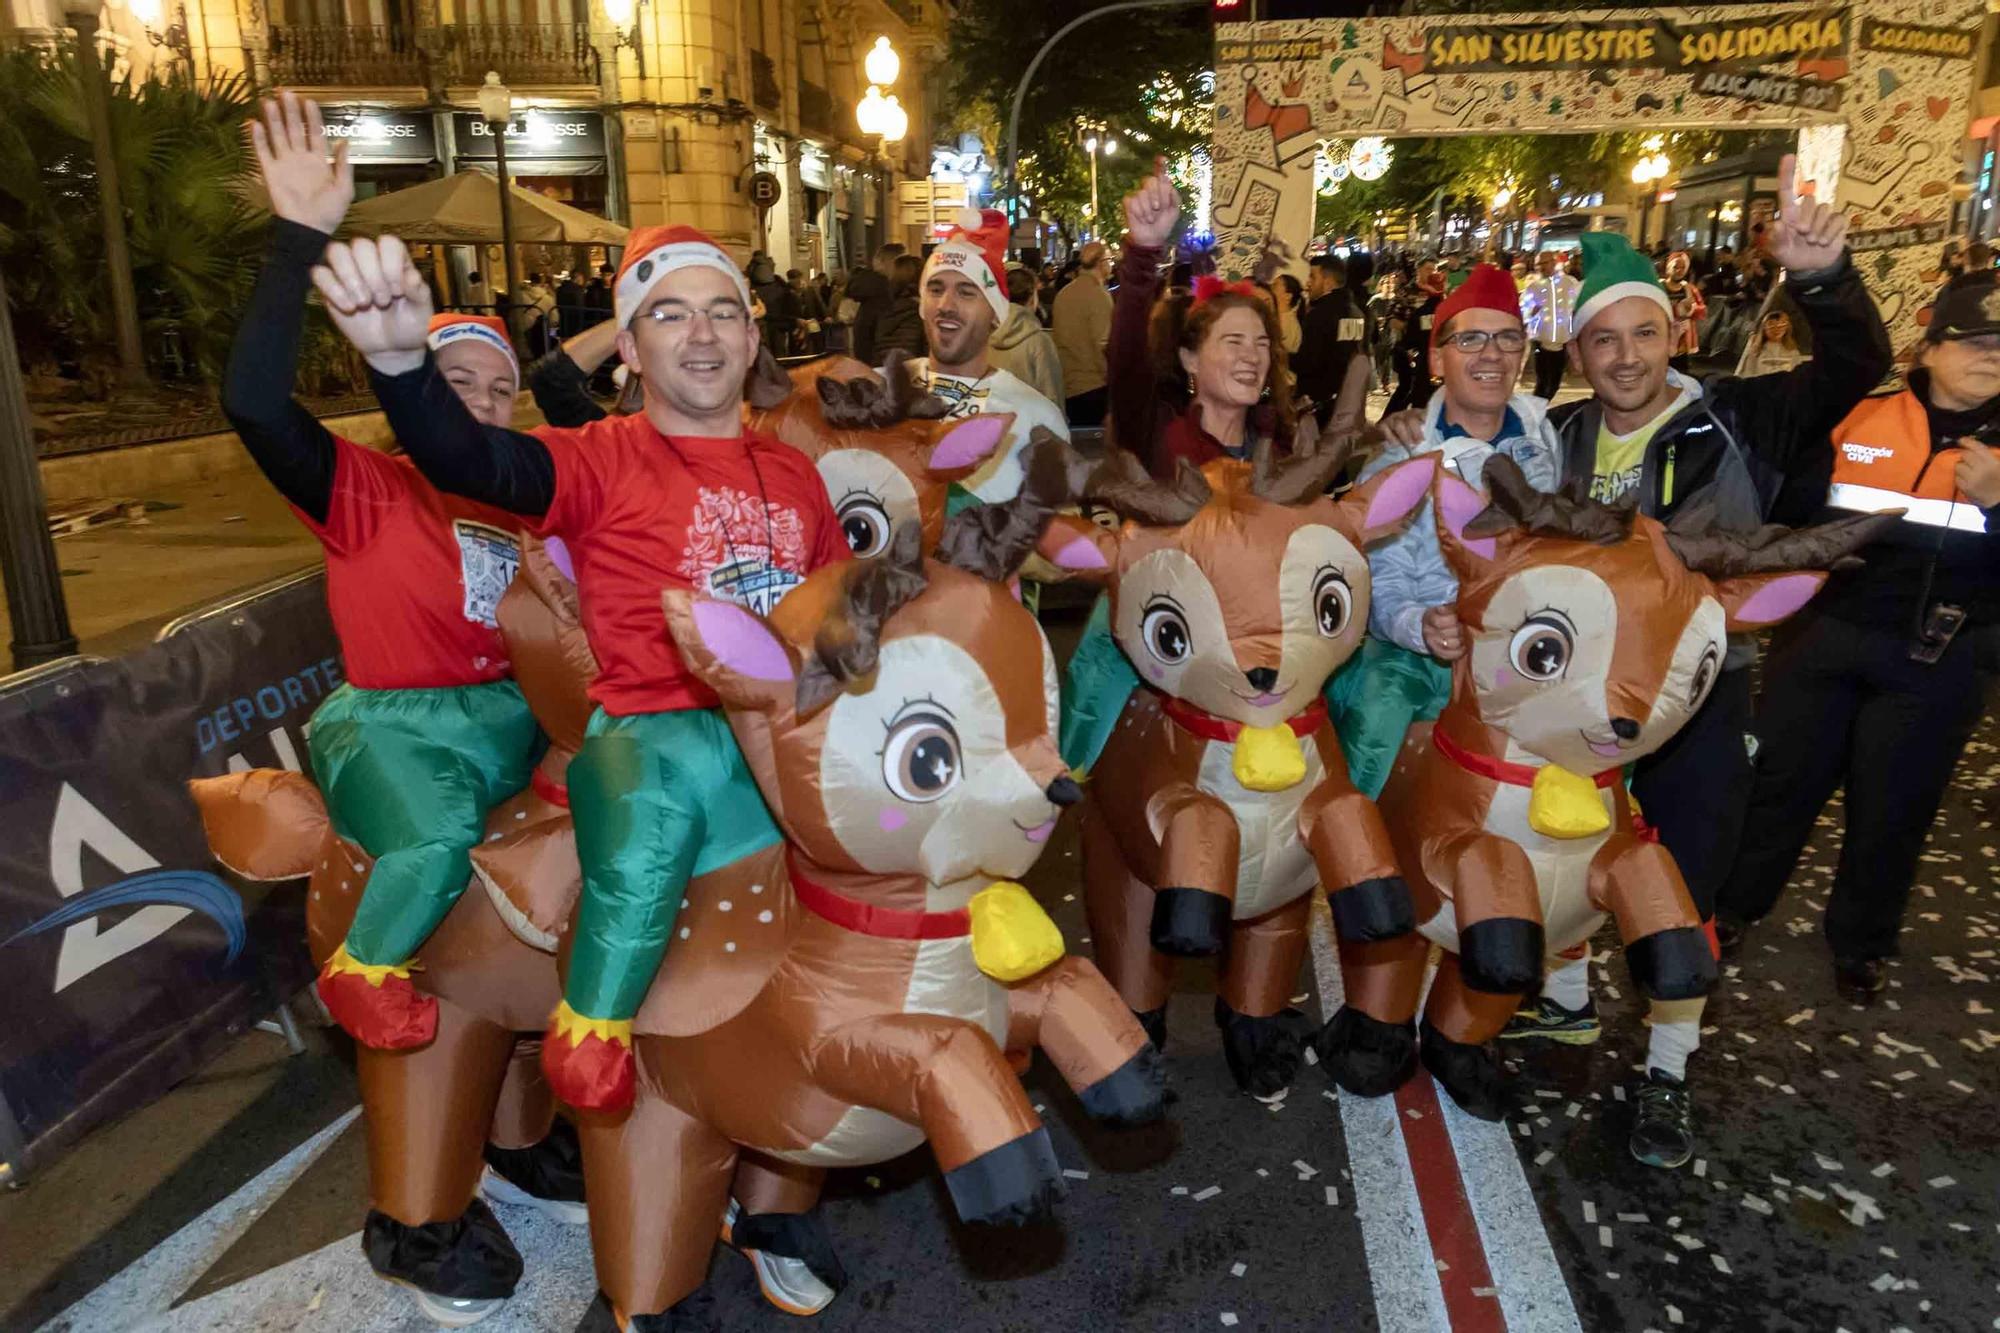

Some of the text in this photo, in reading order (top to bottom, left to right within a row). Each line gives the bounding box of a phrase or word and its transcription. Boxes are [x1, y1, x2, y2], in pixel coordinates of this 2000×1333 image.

[1431, 18, 1841, 67] SAN SILVESTRE SOLIDARIA
[1871, 27, 1971, 51] SOLIDARIA
[1701, 72, 1801, 104] ALICANTE
[756, 181, 773, 199] B
[196, 656, 343, 753] DEPORTE
